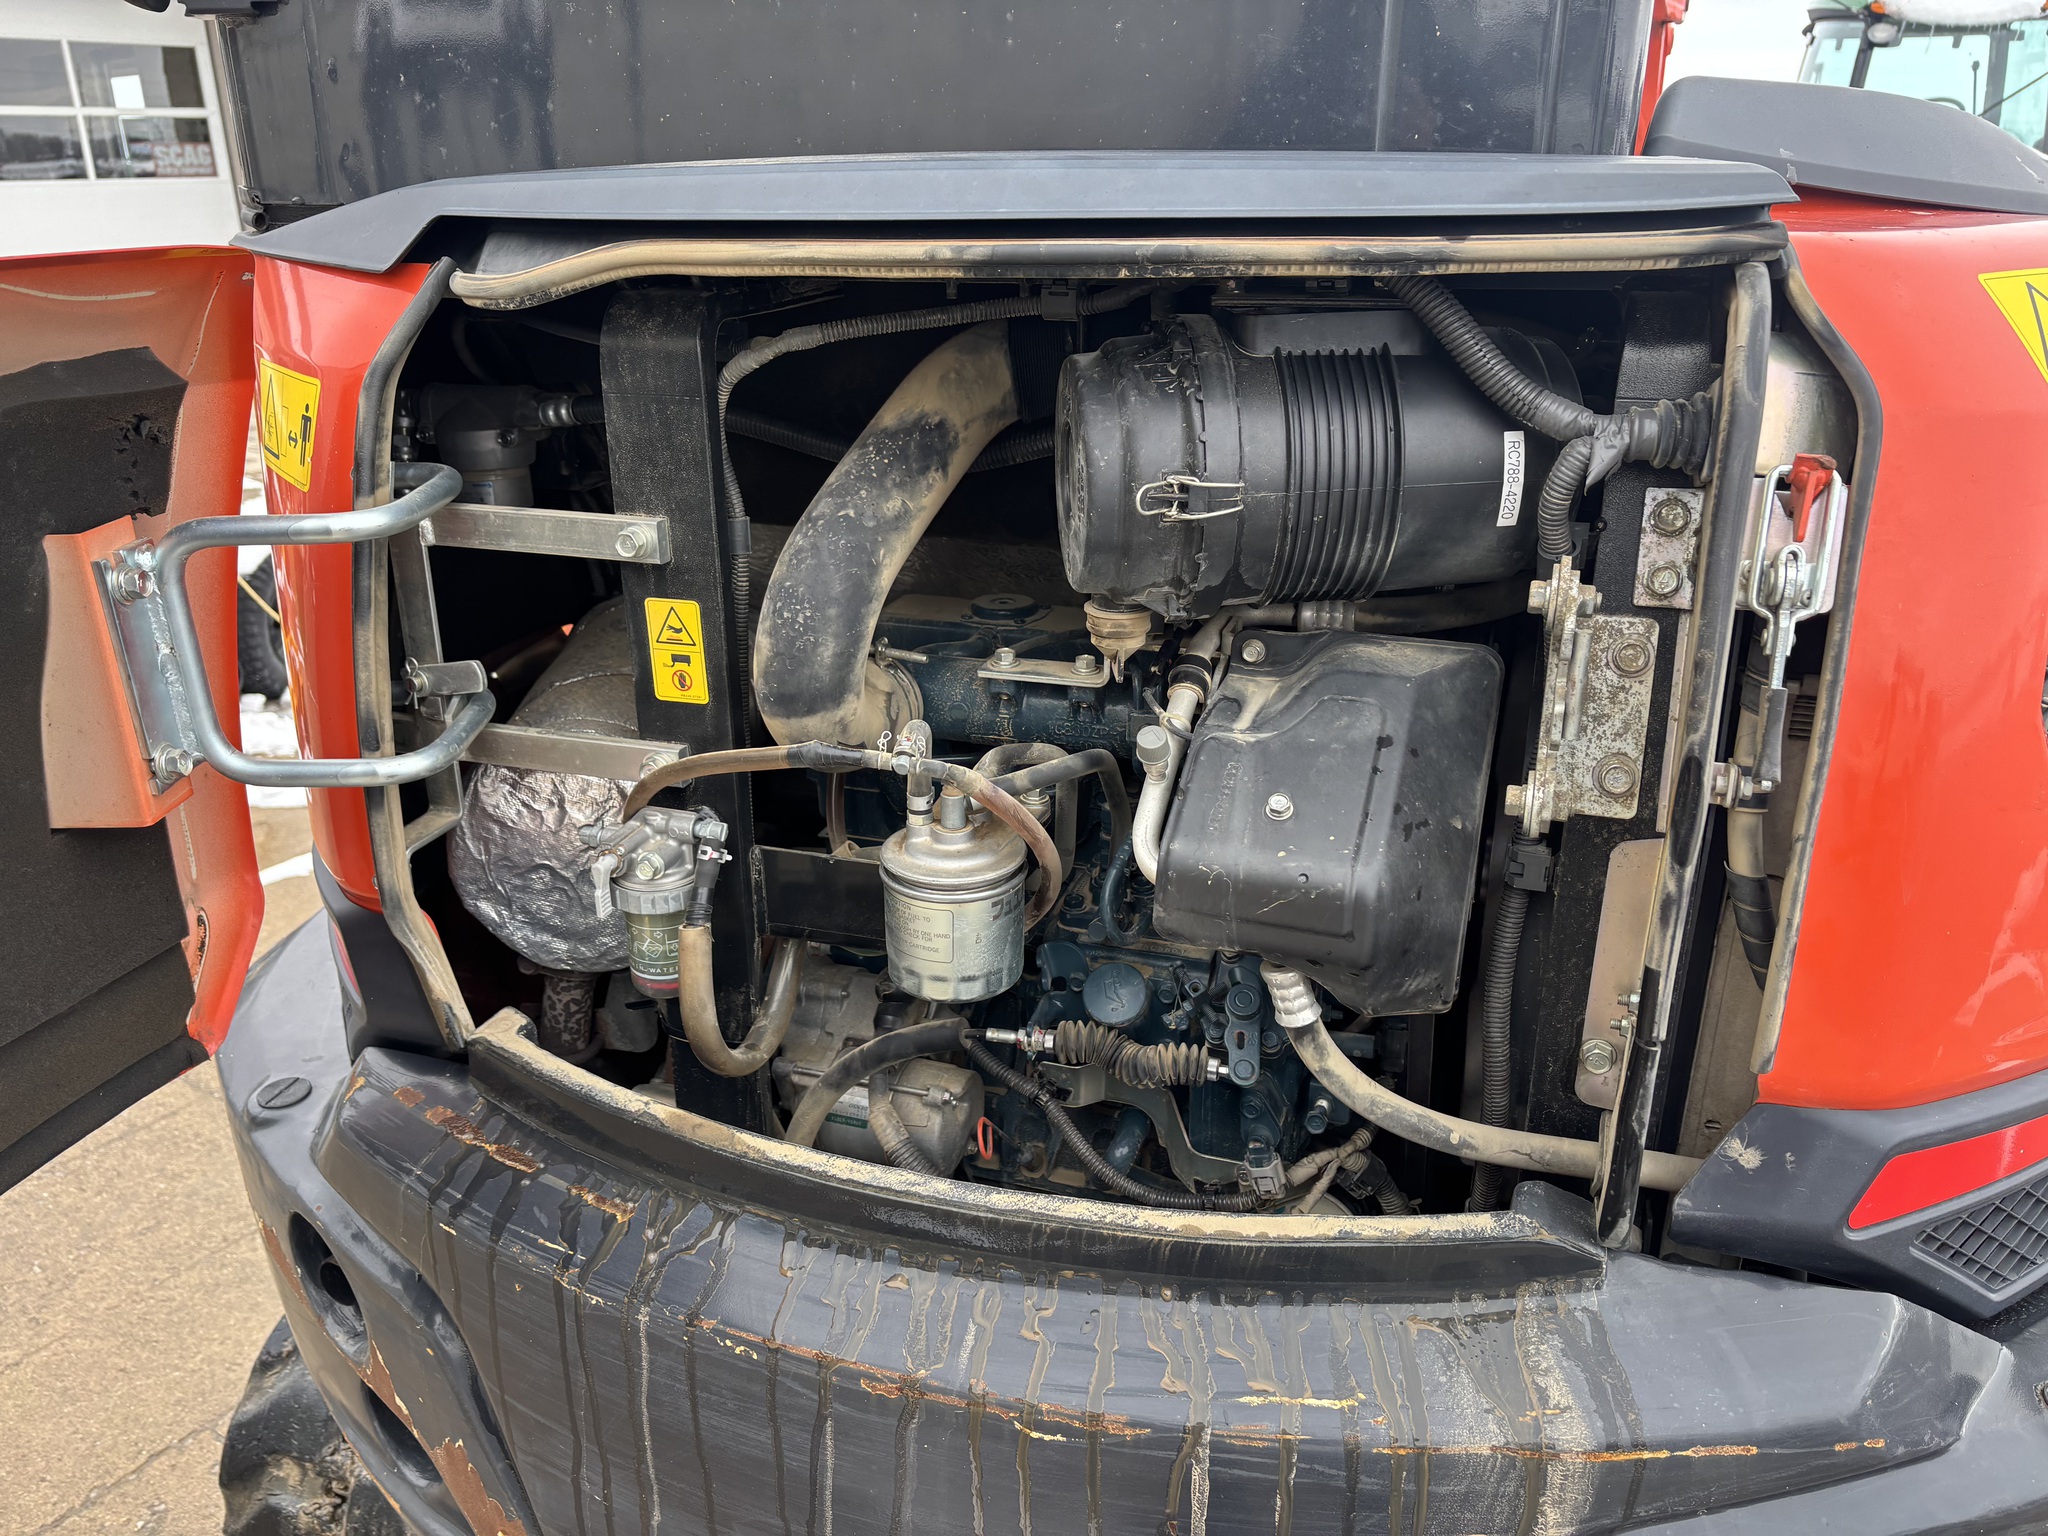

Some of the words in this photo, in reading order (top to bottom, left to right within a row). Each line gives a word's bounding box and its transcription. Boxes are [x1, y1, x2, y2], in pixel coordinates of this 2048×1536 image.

[154, 144, 212, 166] SCAG
[1501, 440, 1520, 520] RC788-4220
[908, 912, 921, 921] FUEL
